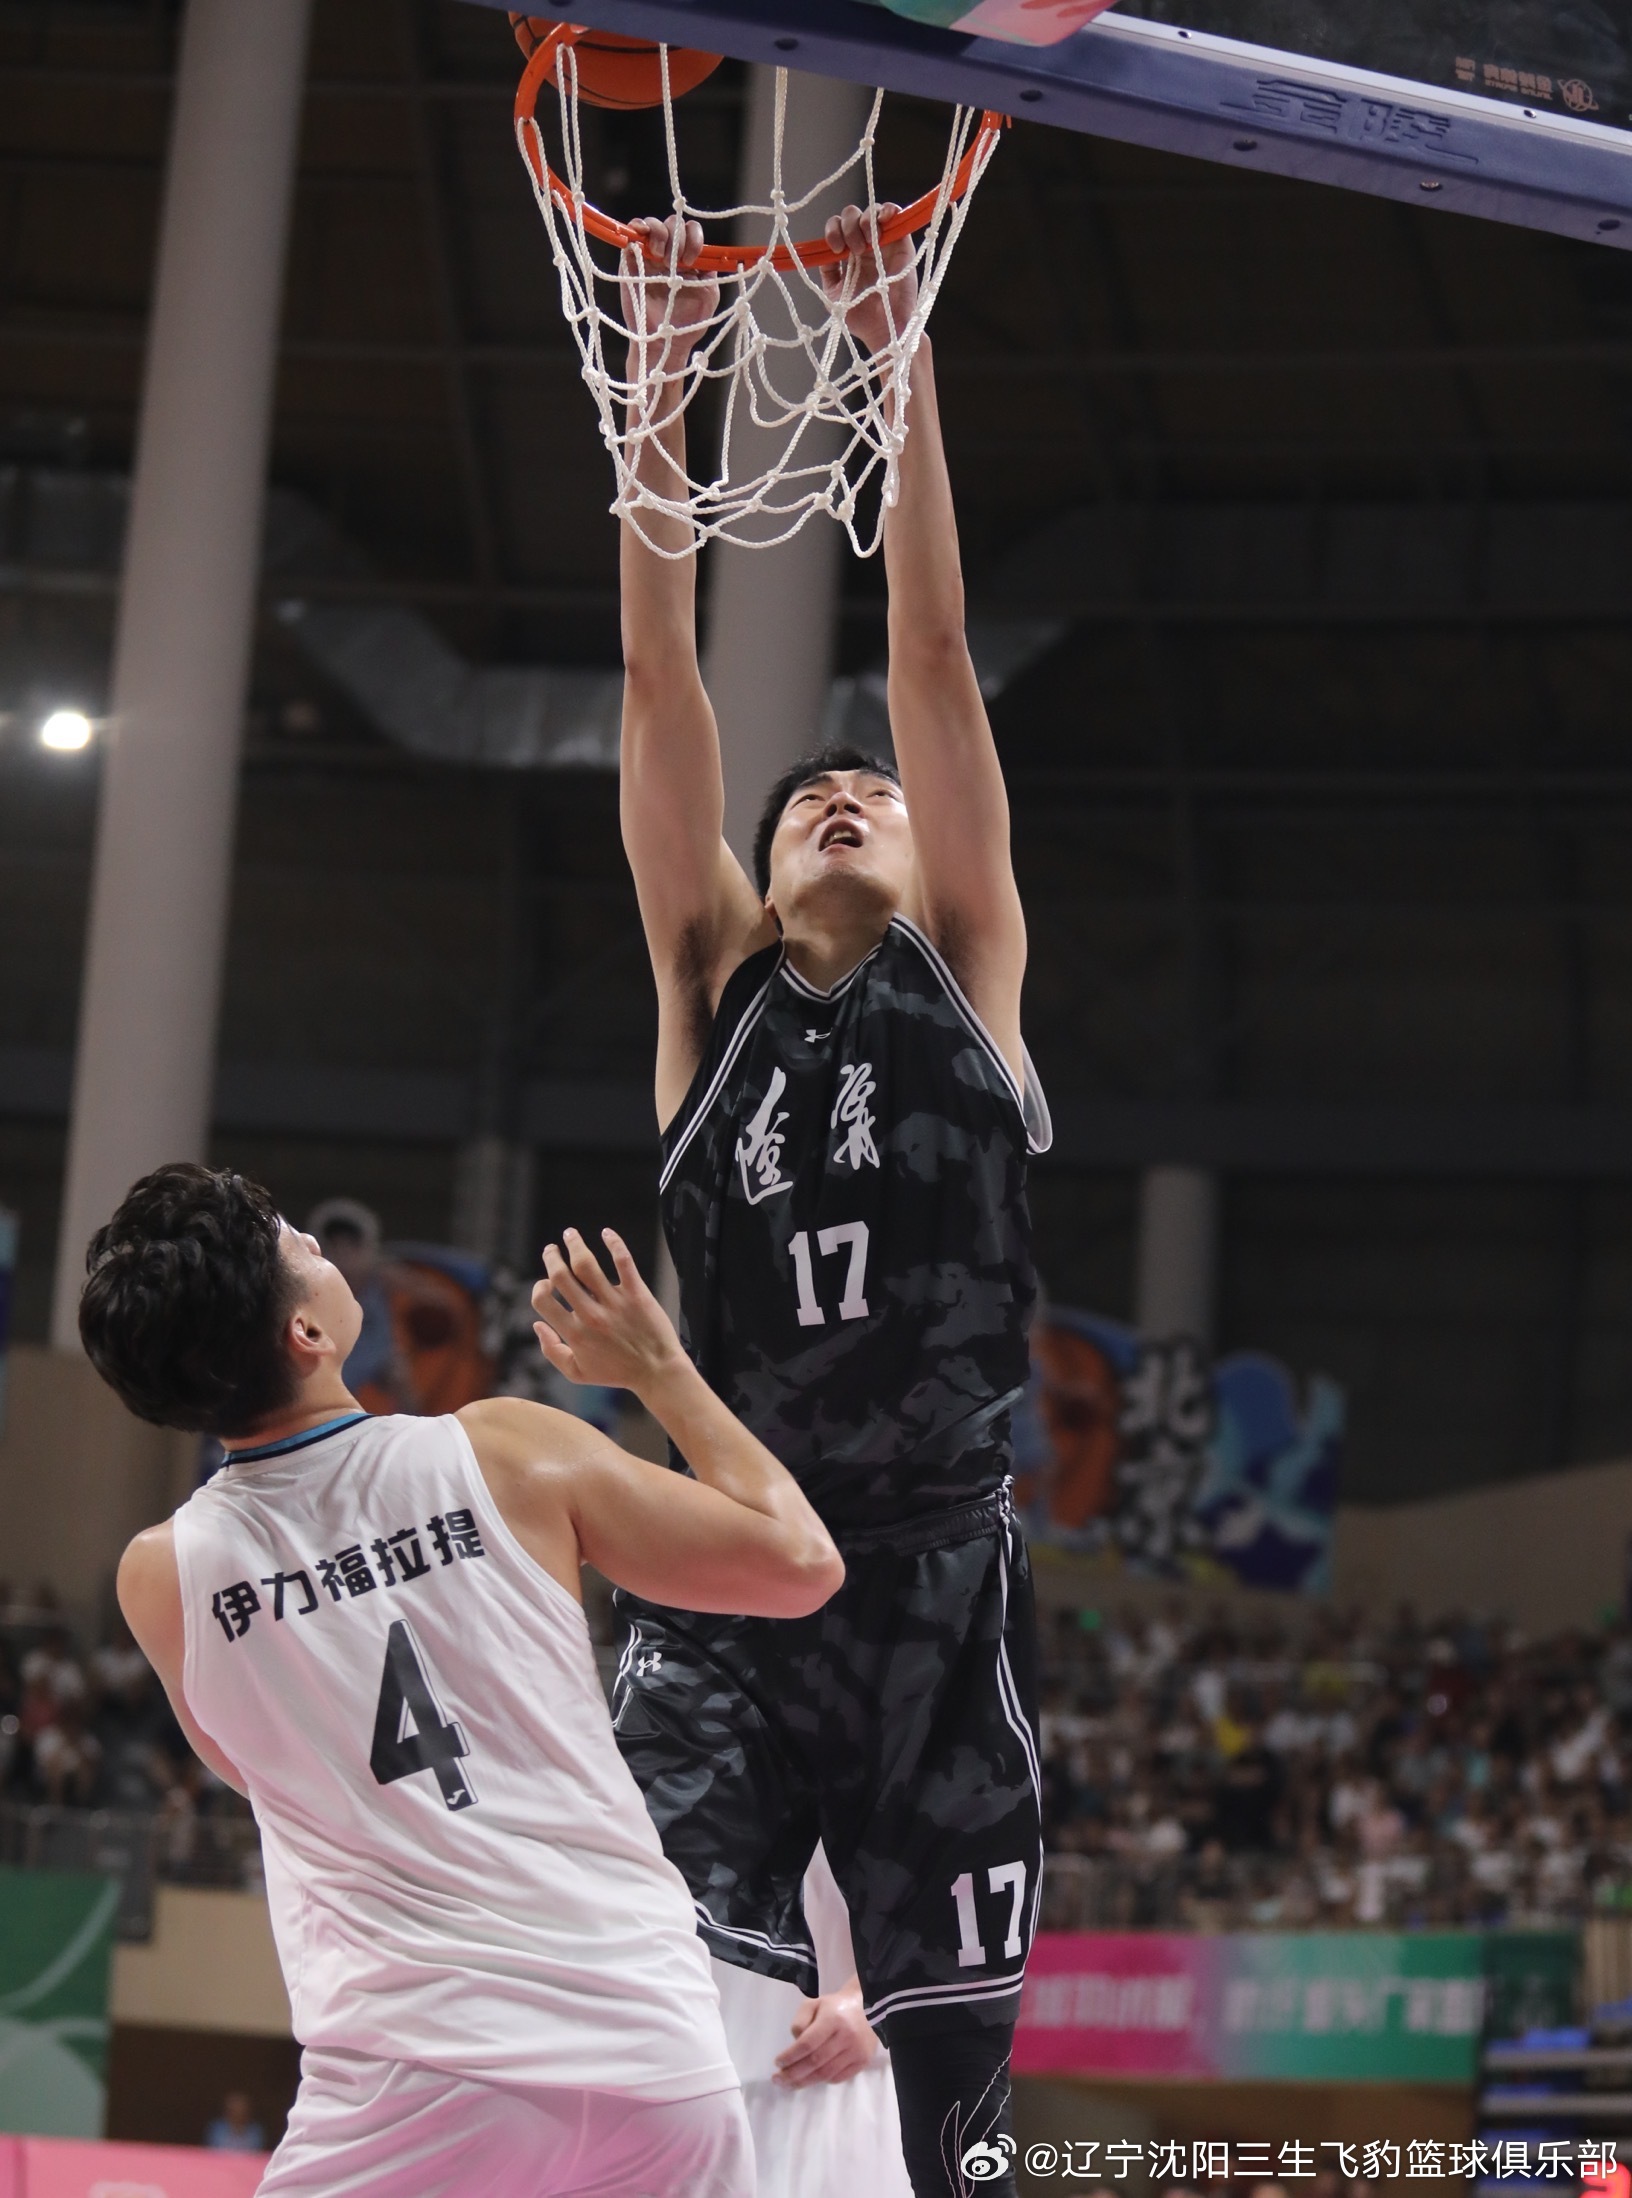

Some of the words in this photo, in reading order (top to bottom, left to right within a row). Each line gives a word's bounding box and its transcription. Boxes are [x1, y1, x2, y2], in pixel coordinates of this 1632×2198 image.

[788, 1220, 870, 1327] 17
[211, 1508, 486, 1643] 伊力福拉提
[369, 1618, 479, 1812] 4
[950, 1860, 1028, 1968] 17
